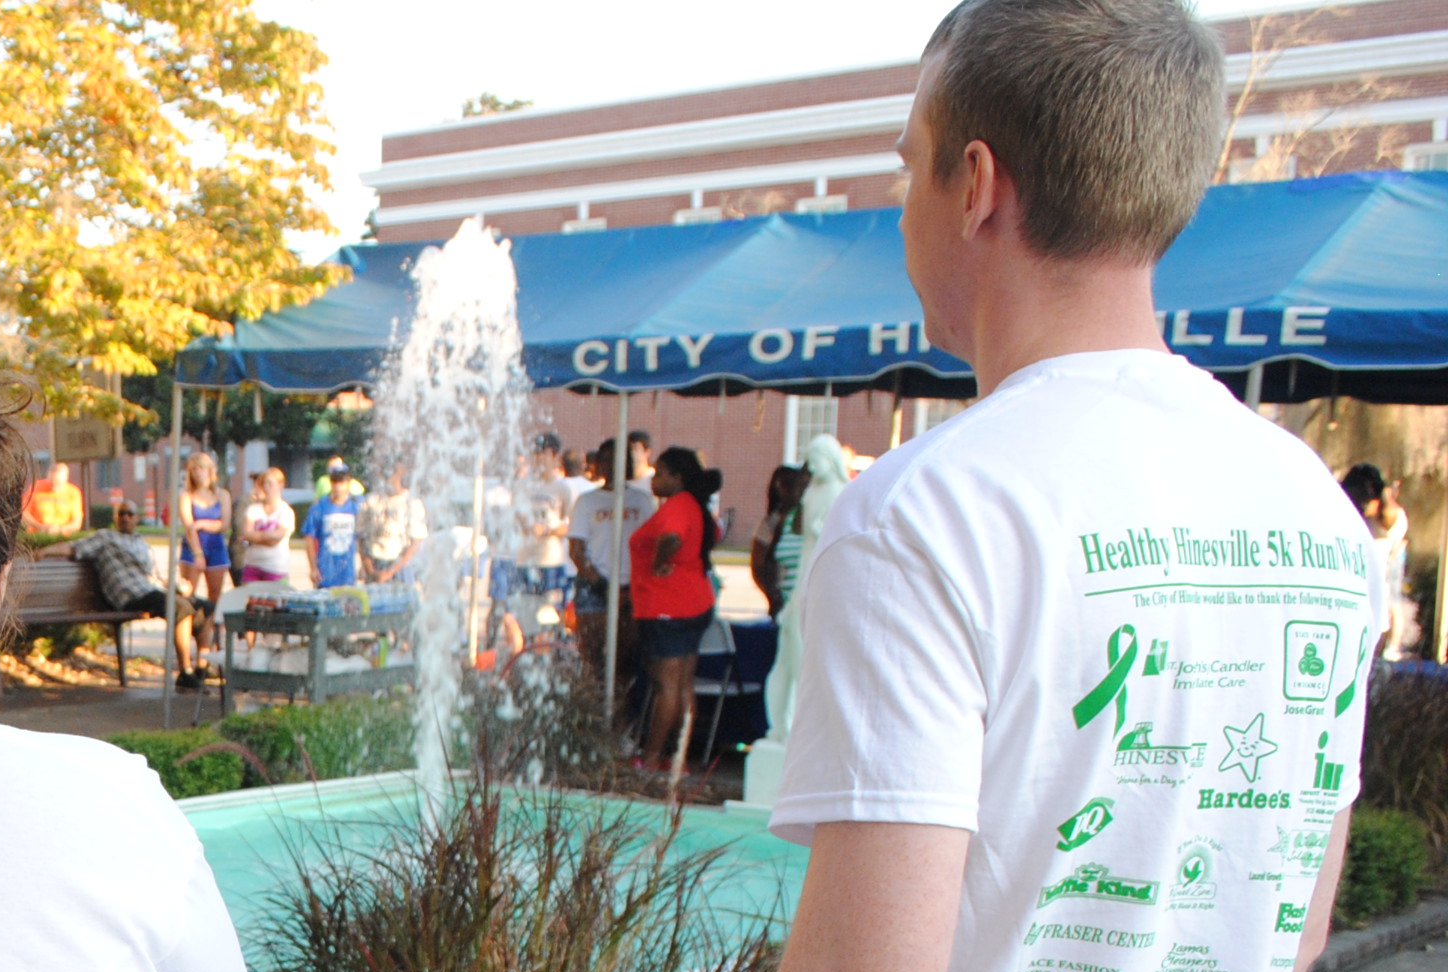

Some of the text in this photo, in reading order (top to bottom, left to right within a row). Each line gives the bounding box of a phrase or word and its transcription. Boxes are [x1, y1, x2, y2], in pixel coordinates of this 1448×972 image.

[572, 332, 715, 376] CITY
[748, 325, 840, 365] OF
[1078, 527, 1169, 576] Healthy
[1171, 526, 1261, 568] Hinesville
[1266, 529, 1294, 568] 5k
[1133, 593, 1151, 608] The
[1152, 591, 1168, 608] City
[1244, 592, 1255, 605] to
[1257, 592, 1281, 605] thank
[1283, 592, 1297, 605] the
[1210, 660, 1265, 673] Candler
[1217, 677, 1246, 688] Care
[1196, 788, 1292, 810] Hardee's
[1042, 923, 1104, 944] FRASER
[1027, 958, 1055, 968] ACE
[1161, 952, 1219, 969] Cleaners
